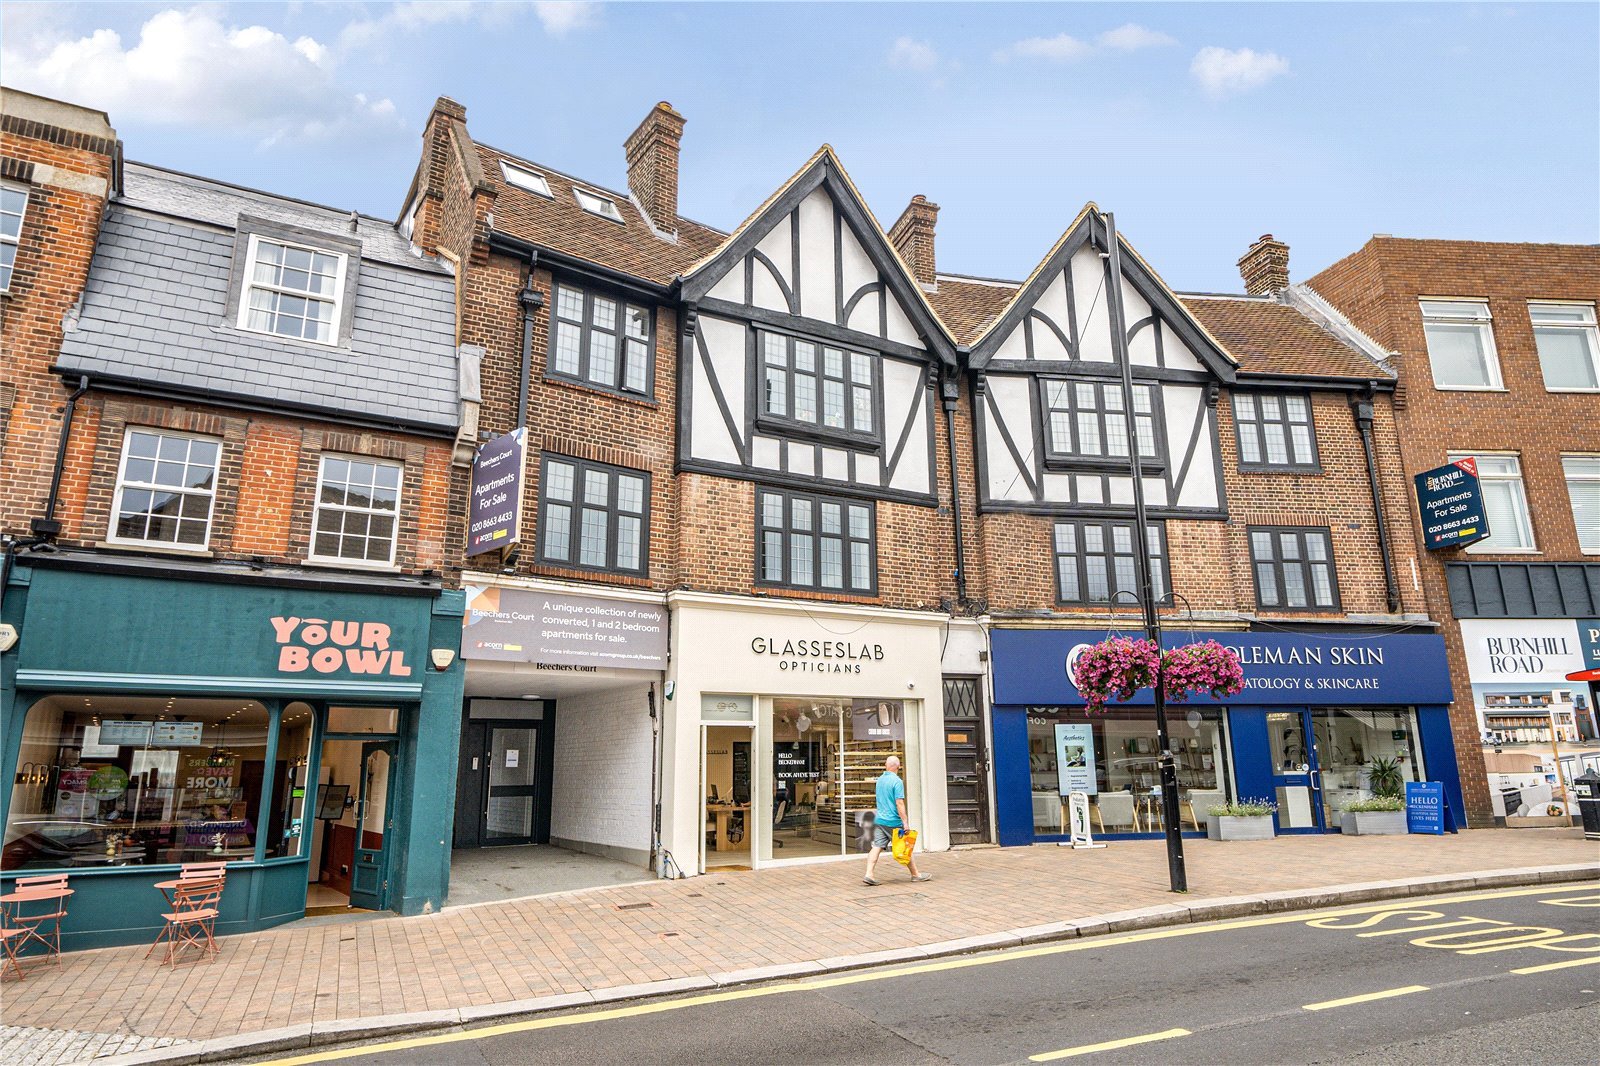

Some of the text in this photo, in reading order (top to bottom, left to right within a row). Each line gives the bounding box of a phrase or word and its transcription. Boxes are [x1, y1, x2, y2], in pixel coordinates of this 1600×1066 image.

[480, 456, 499, 468] Beechers
[500, 449, 513, 460] Court
[475, 473, 515, 496] Apartments
[1432, 470, 1465, 484] BURNHILL
[1433, 480, 1454, 492] ROAD
[480, 492, 507, 510] For Sale
[1426, 491, 1473, 510] Apartments
[1434, 503, 1468, 518] For Sale
[471, 511, 513, 533] 020 8663 4433
[1428, 515, 1480, 533] 020 8663 4433
[472, 609, 535, 621] Beechers Court
[543, 601, 662, 622] A unique collection of newly
[542, 616, 660, 633] converted, 1 and 2 bedroom
[541, 629, 628, 643] apartments for sale.
[751, 636, 885, 660] GLASSESLAB
[1223, 645, 1384, 665] OLEMAN SKIN
[1486, 637, 1574, 655] BURNHILL
[278, 646, 412, 677] BOWL
[536, 662, 572, 671] Beechers
[779, 660, 861, 674] OPTICIANS
[1489, 655, 1544, 674] ROAD
[1244, 677, 1380, 689] ATOLOGY & SKINCARE
[1411, 797, 1438, 805] HELLO
